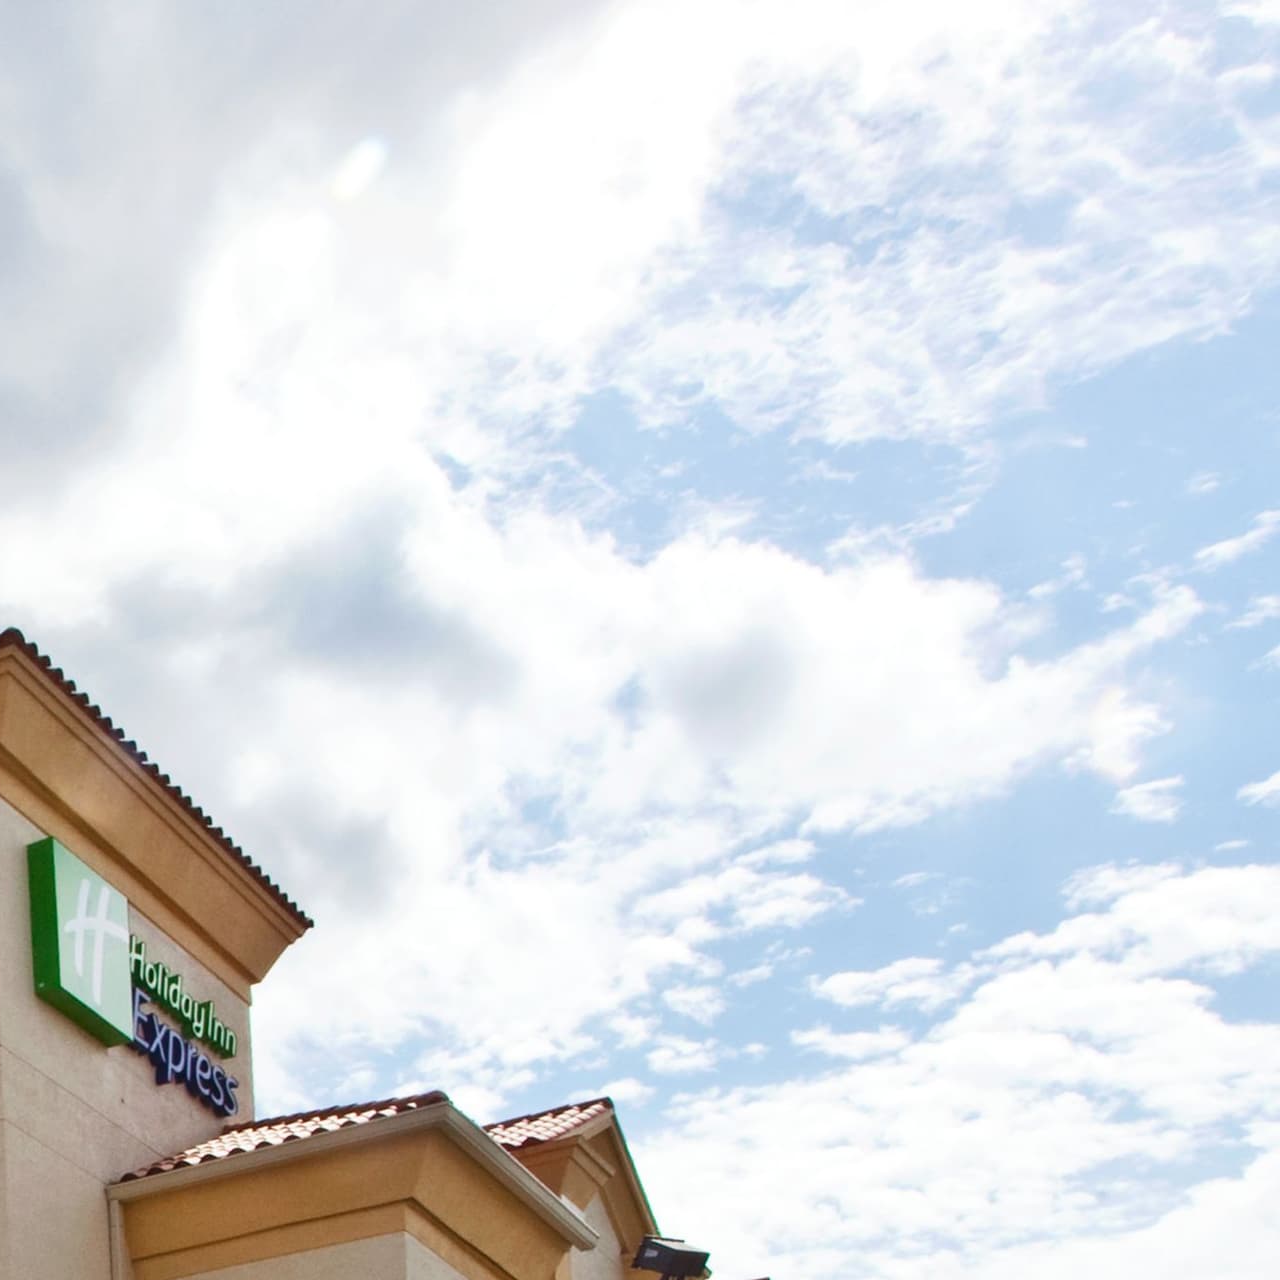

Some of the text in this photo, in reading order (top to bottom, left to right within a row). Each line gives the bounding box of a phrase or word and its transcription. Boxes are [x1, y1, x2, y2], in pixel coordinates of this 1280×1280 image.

[128, 934, 237, 1059] Holiday Inn
[130, 986, 239, 1117] Express
